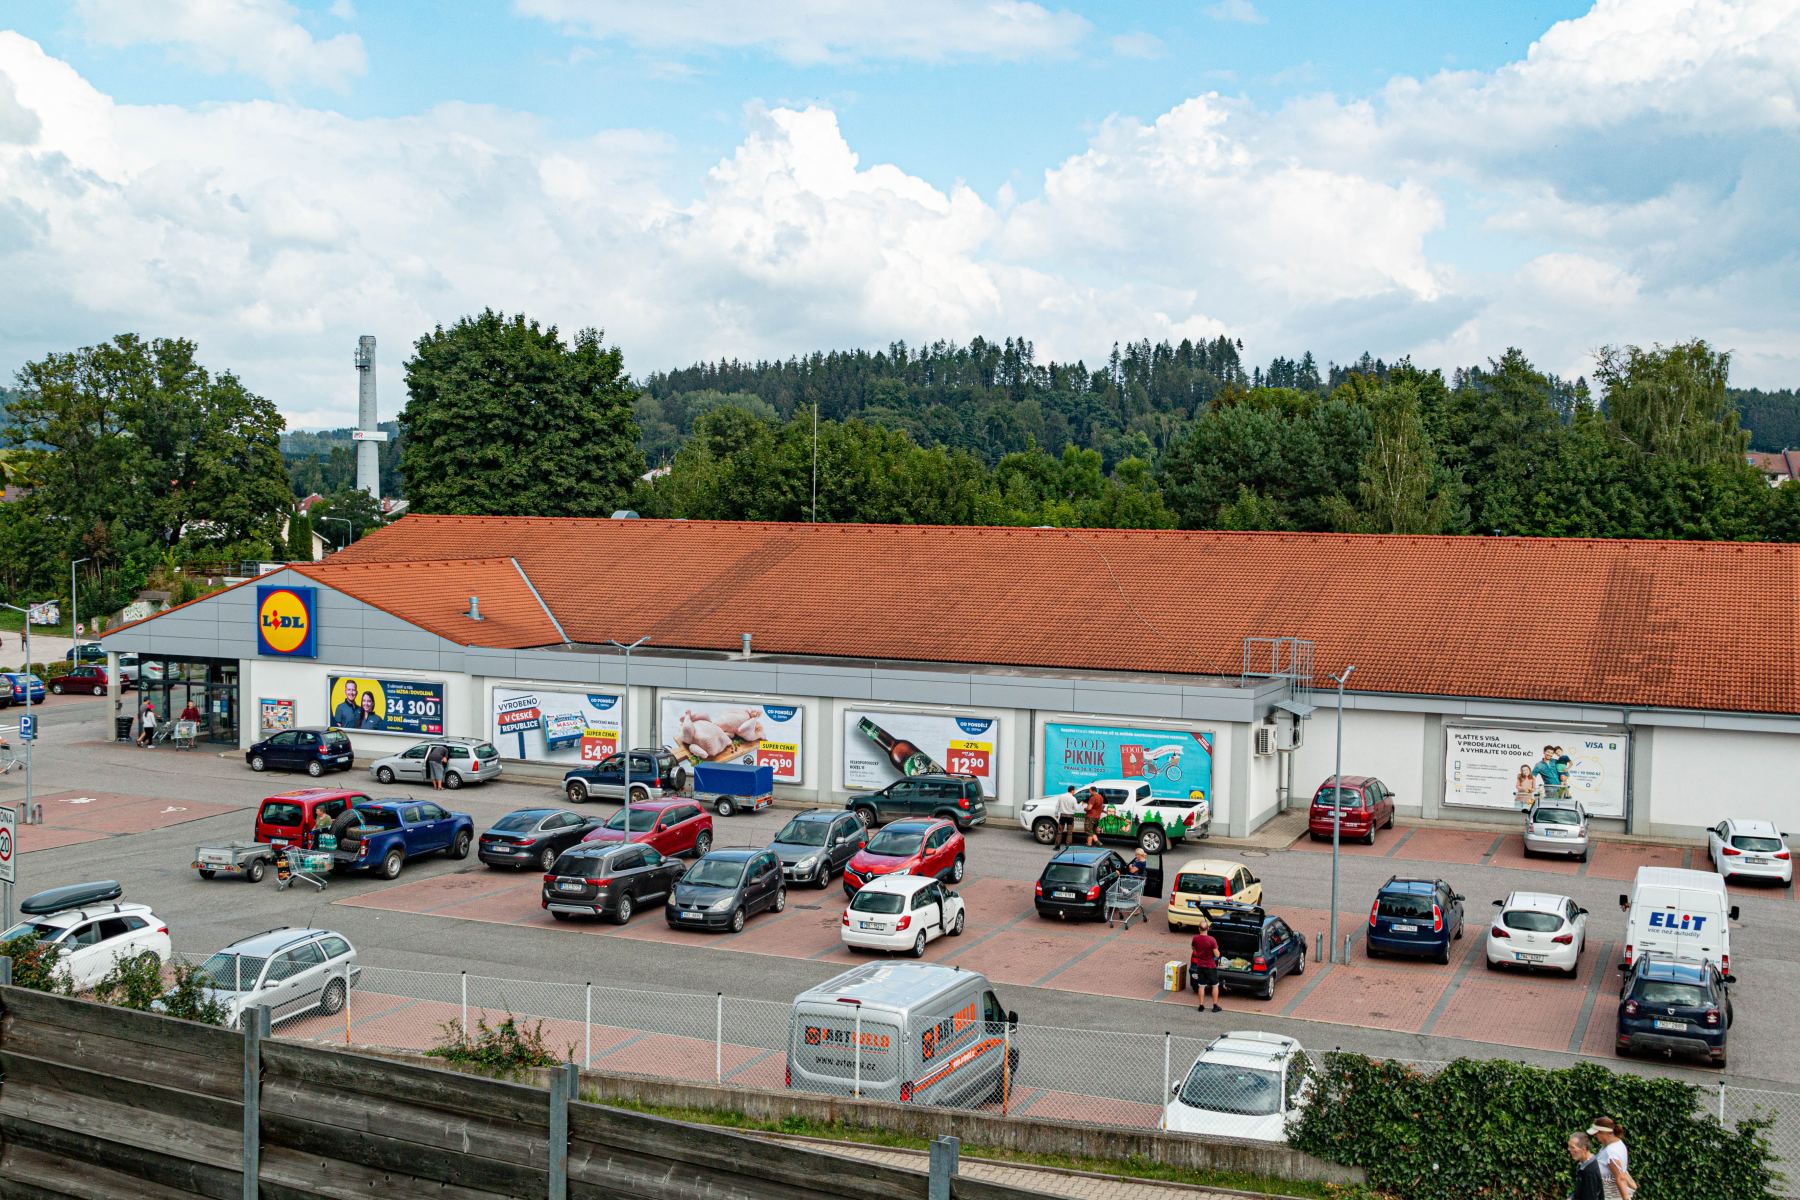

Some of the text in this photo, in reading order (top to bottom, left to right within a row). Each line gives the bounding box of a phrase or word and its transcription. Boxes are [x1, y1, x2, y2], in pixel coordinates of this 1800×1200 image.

[387, 699, 435, 716] 34 300
[498, 698, 538, 711] VYROBENO
[511, 711, 533, 721] ČESKÉ
[21, 717, 30, 732] P
[502, 720, 539, 732] REPUBLICE
[1066, 737, 1105, 751] FOOD
[1064, 750, 1105, 766] PIKNIK
[0, 836, 9, 853] 20
